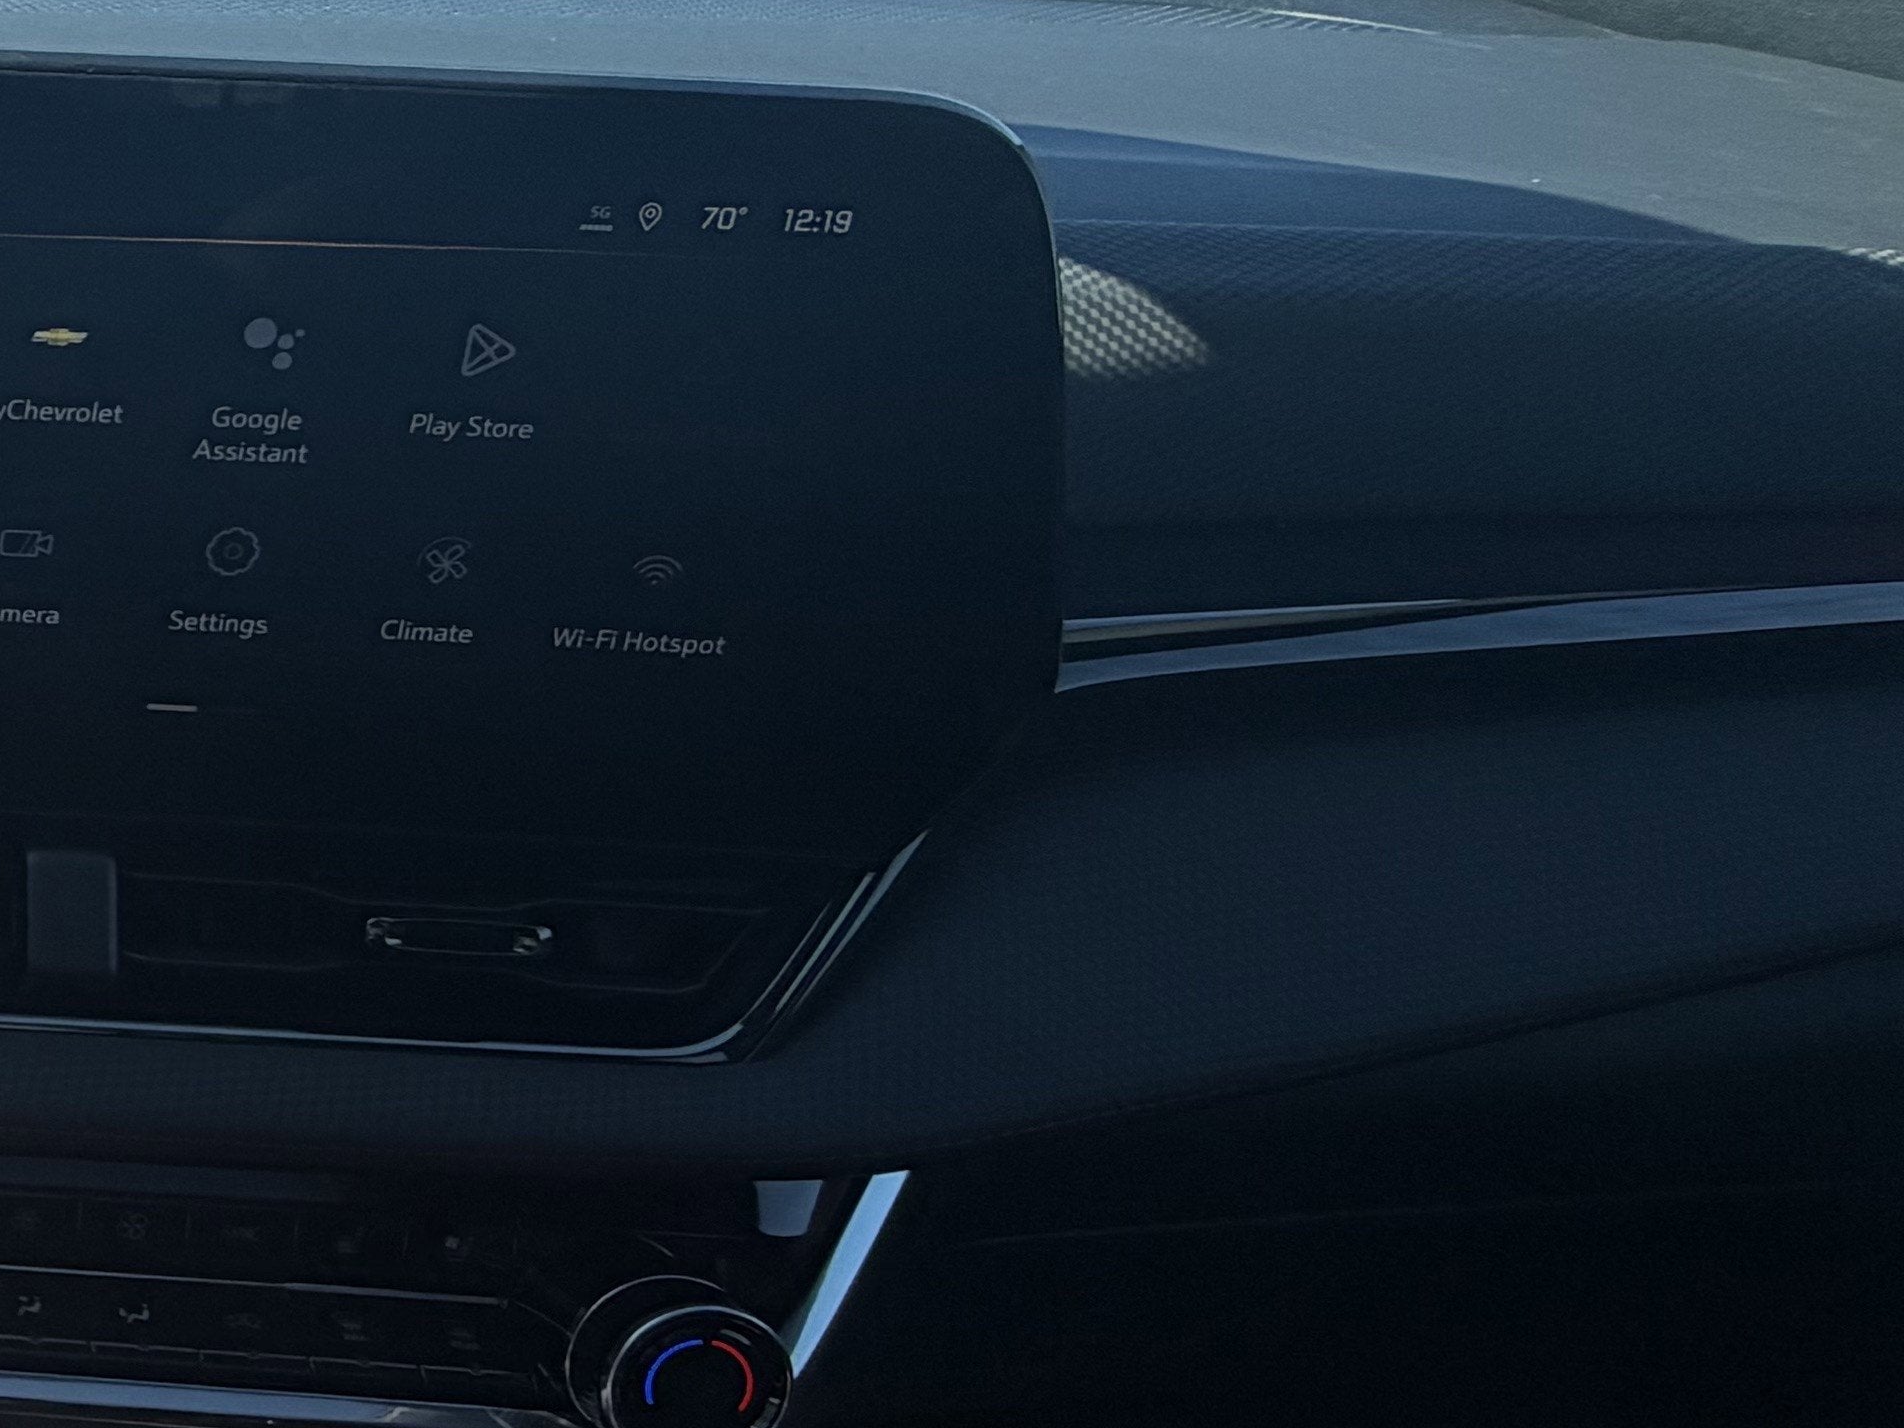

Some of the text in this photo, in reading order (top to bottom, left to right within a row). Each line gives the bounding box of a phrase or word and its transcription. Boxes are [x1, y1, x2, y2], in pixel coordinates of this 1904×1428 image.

[701, 206, 853, 234] 70° 12:19
[211, 407, 303, 436] Google
[409, 413, 534, 441] Play Store
[192, 440, 308, 465] Assistant
[168, 610, 269, 638] Settings
[380, 620, 474, 644] Climate
[552, 627, 727, 658] Wi-Fi Hotspot
